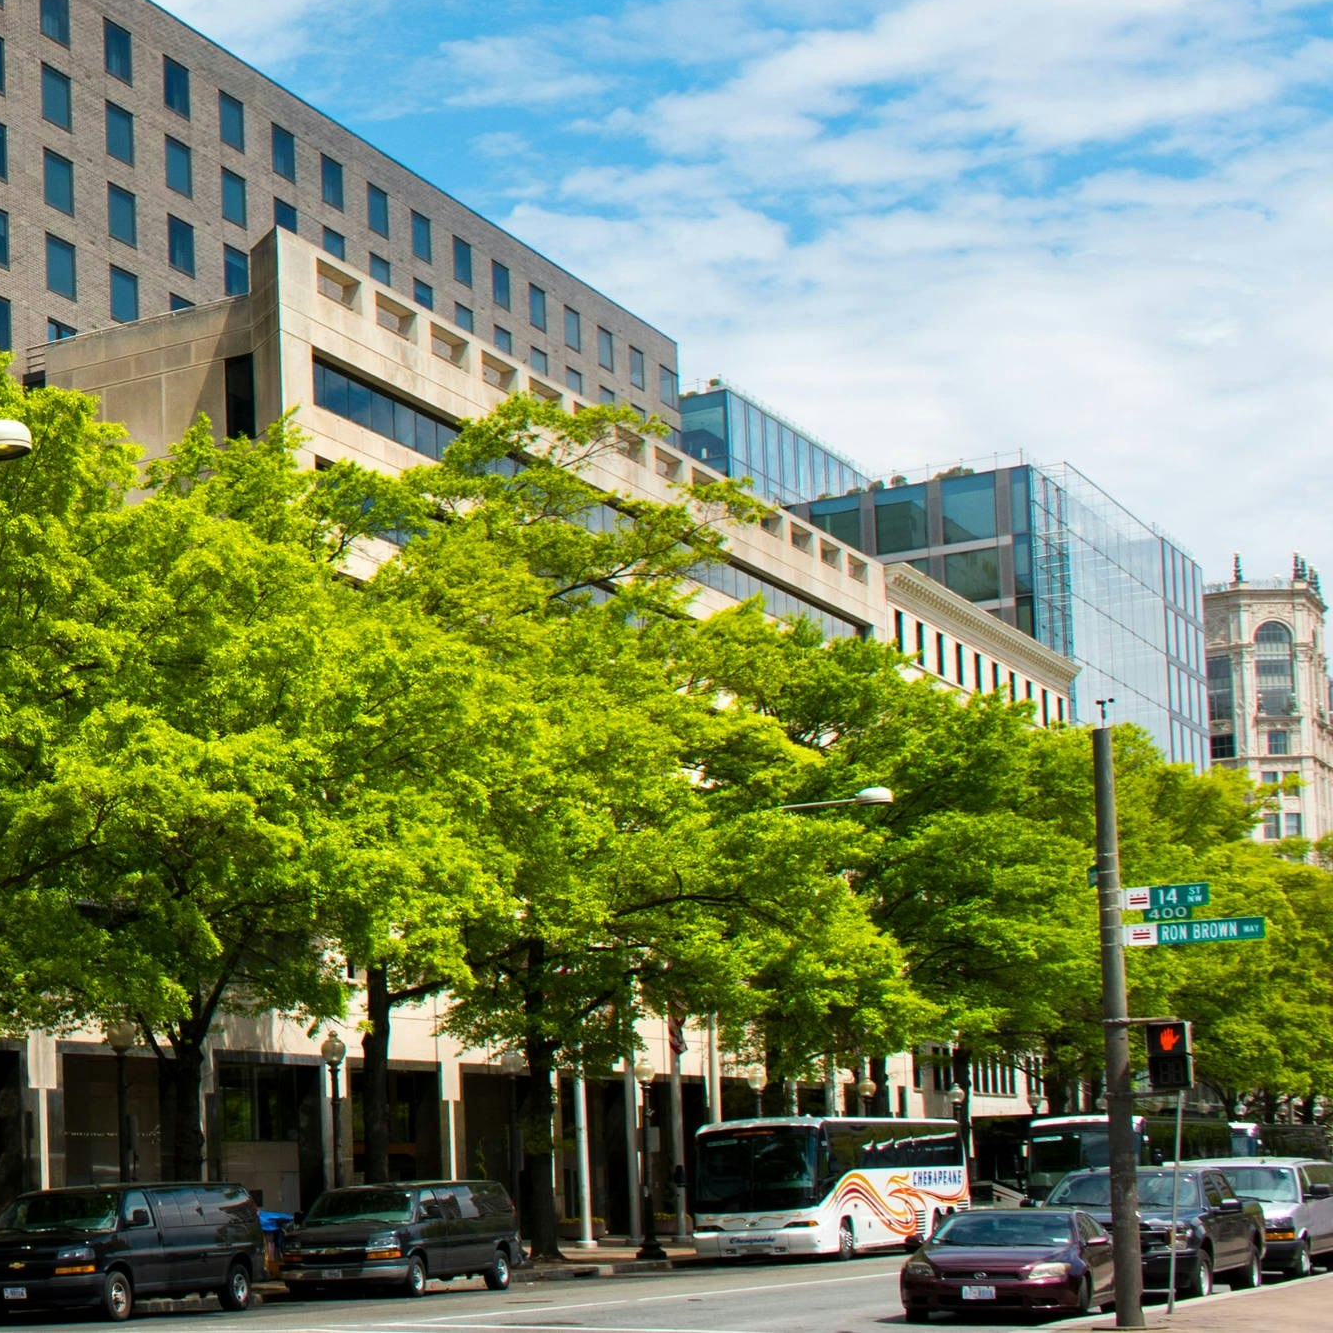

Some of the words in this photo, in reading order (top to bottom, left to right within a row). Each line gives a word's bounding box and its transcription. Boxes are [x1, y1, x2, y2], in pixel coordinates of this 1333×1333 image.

[1157, 888, 1178, 905] 14
[1188, 886, 1201, 894] ST
[1187, 895, 1202, 903] NW
[1148, 906, 1188, 920] 400
[1161, 925, 1188, 941] RON
[1192, 921, 1238, 939] BROWN
[1243, 924, 1259, 933] WAY
[913, 1170, 962, 1186] CHESAPEAKE
